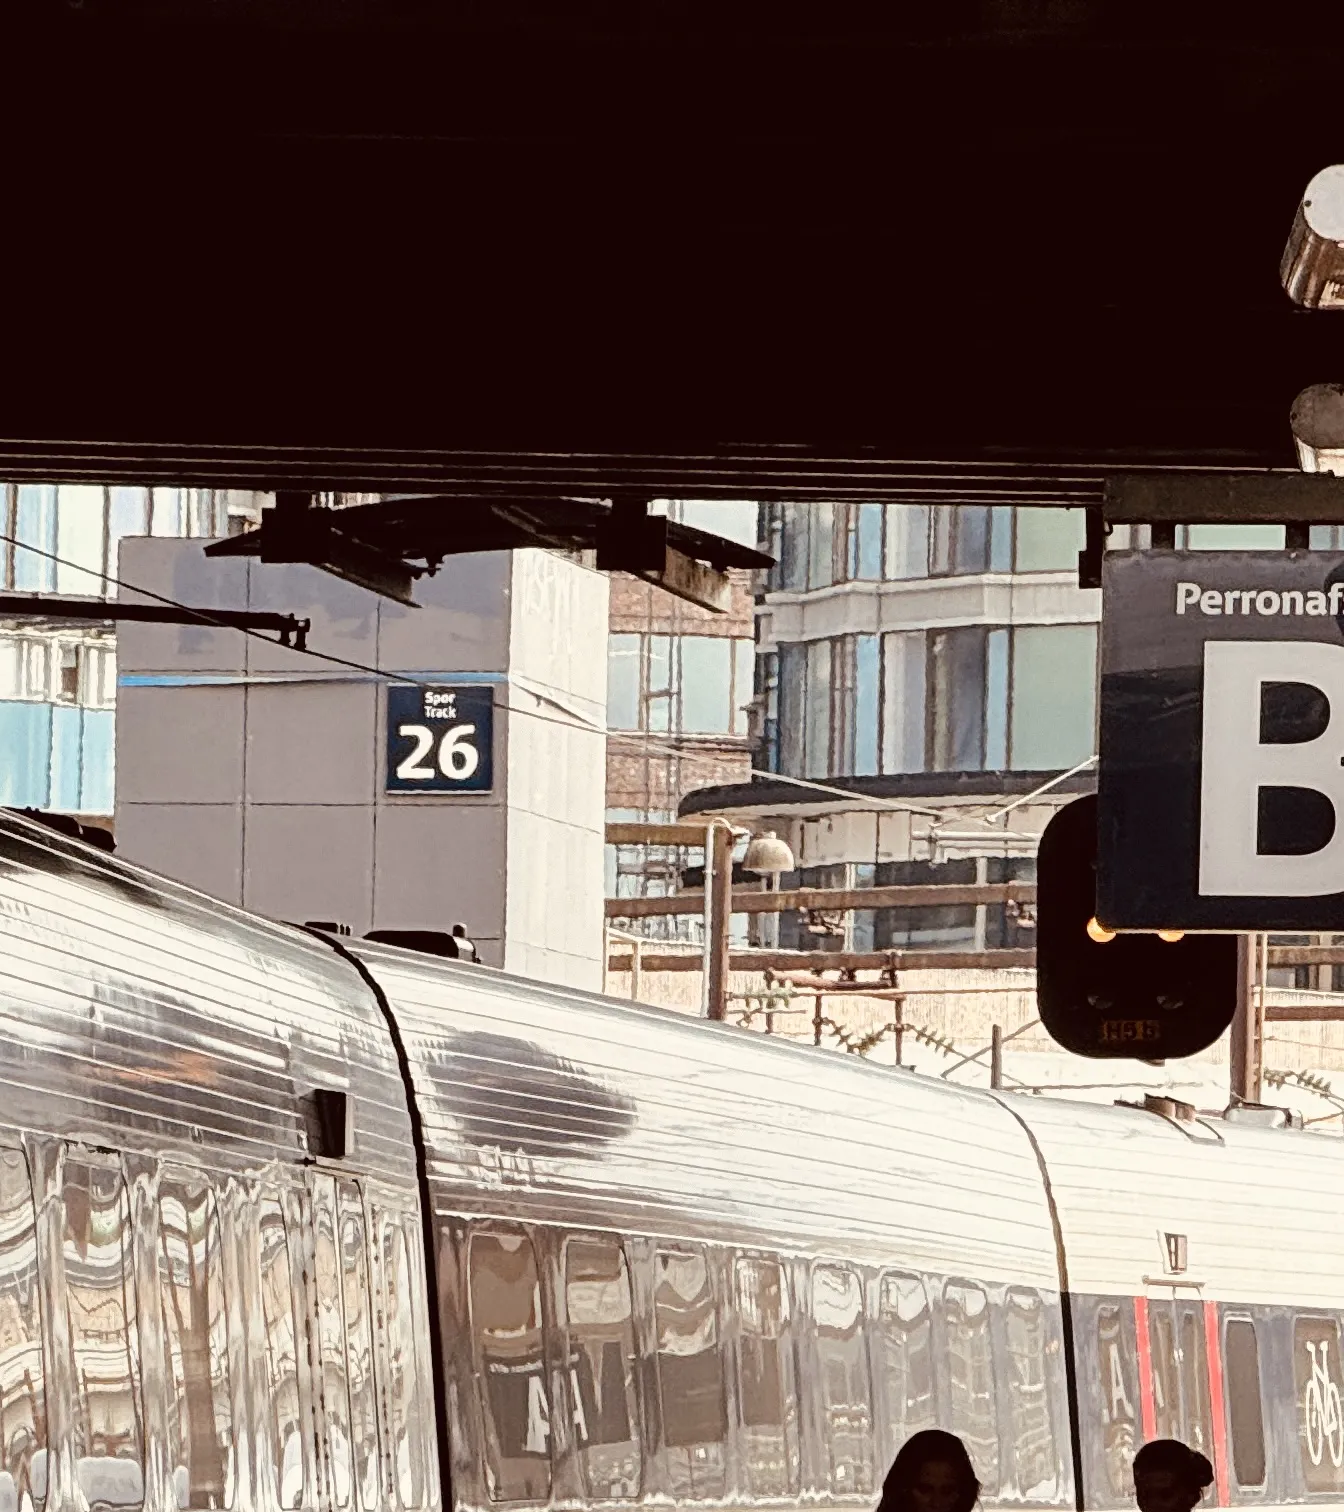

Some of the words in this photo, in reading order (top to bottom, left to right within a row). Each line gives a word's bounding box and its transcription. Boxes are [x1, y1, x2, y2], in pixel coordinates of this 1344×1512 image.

[1176, 582, 1344, 616] Perronaf
[424, 691, 456, 706] Spor
[424, 706, 456, 718] Track
[396, 724, 479, 780] 26
[1199, 640, 1344, 896] B
